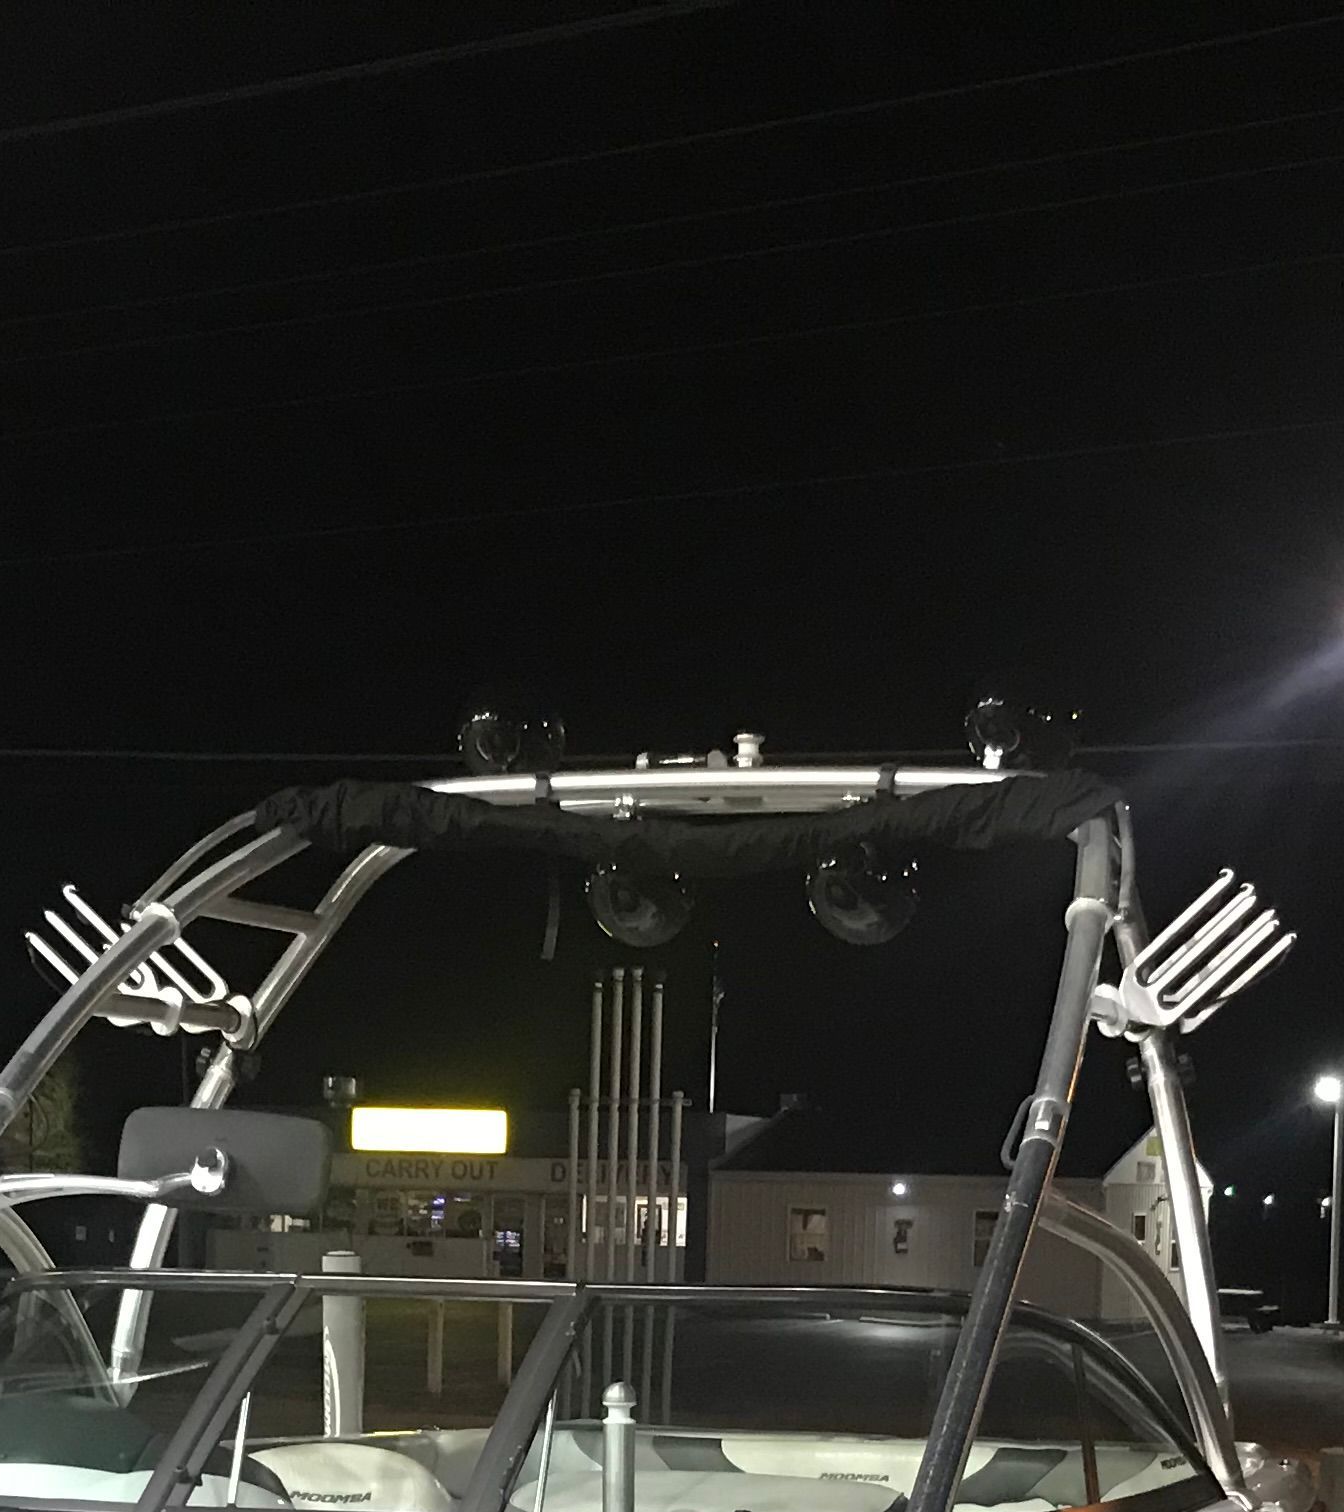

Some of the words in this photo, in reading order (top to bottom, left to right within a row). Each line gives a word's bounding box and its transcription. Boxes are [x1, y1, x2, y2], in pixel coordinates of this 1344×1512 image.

[365, 1158, 444, 1180] CARRY
[451, 1160, 498, 1181] OUT
[551, 1161, 673, 1185] DEIVEY
[819, 1472, 890, 1483] MOOMBA
[290, 1490, 372, 1504] MOOMBA
